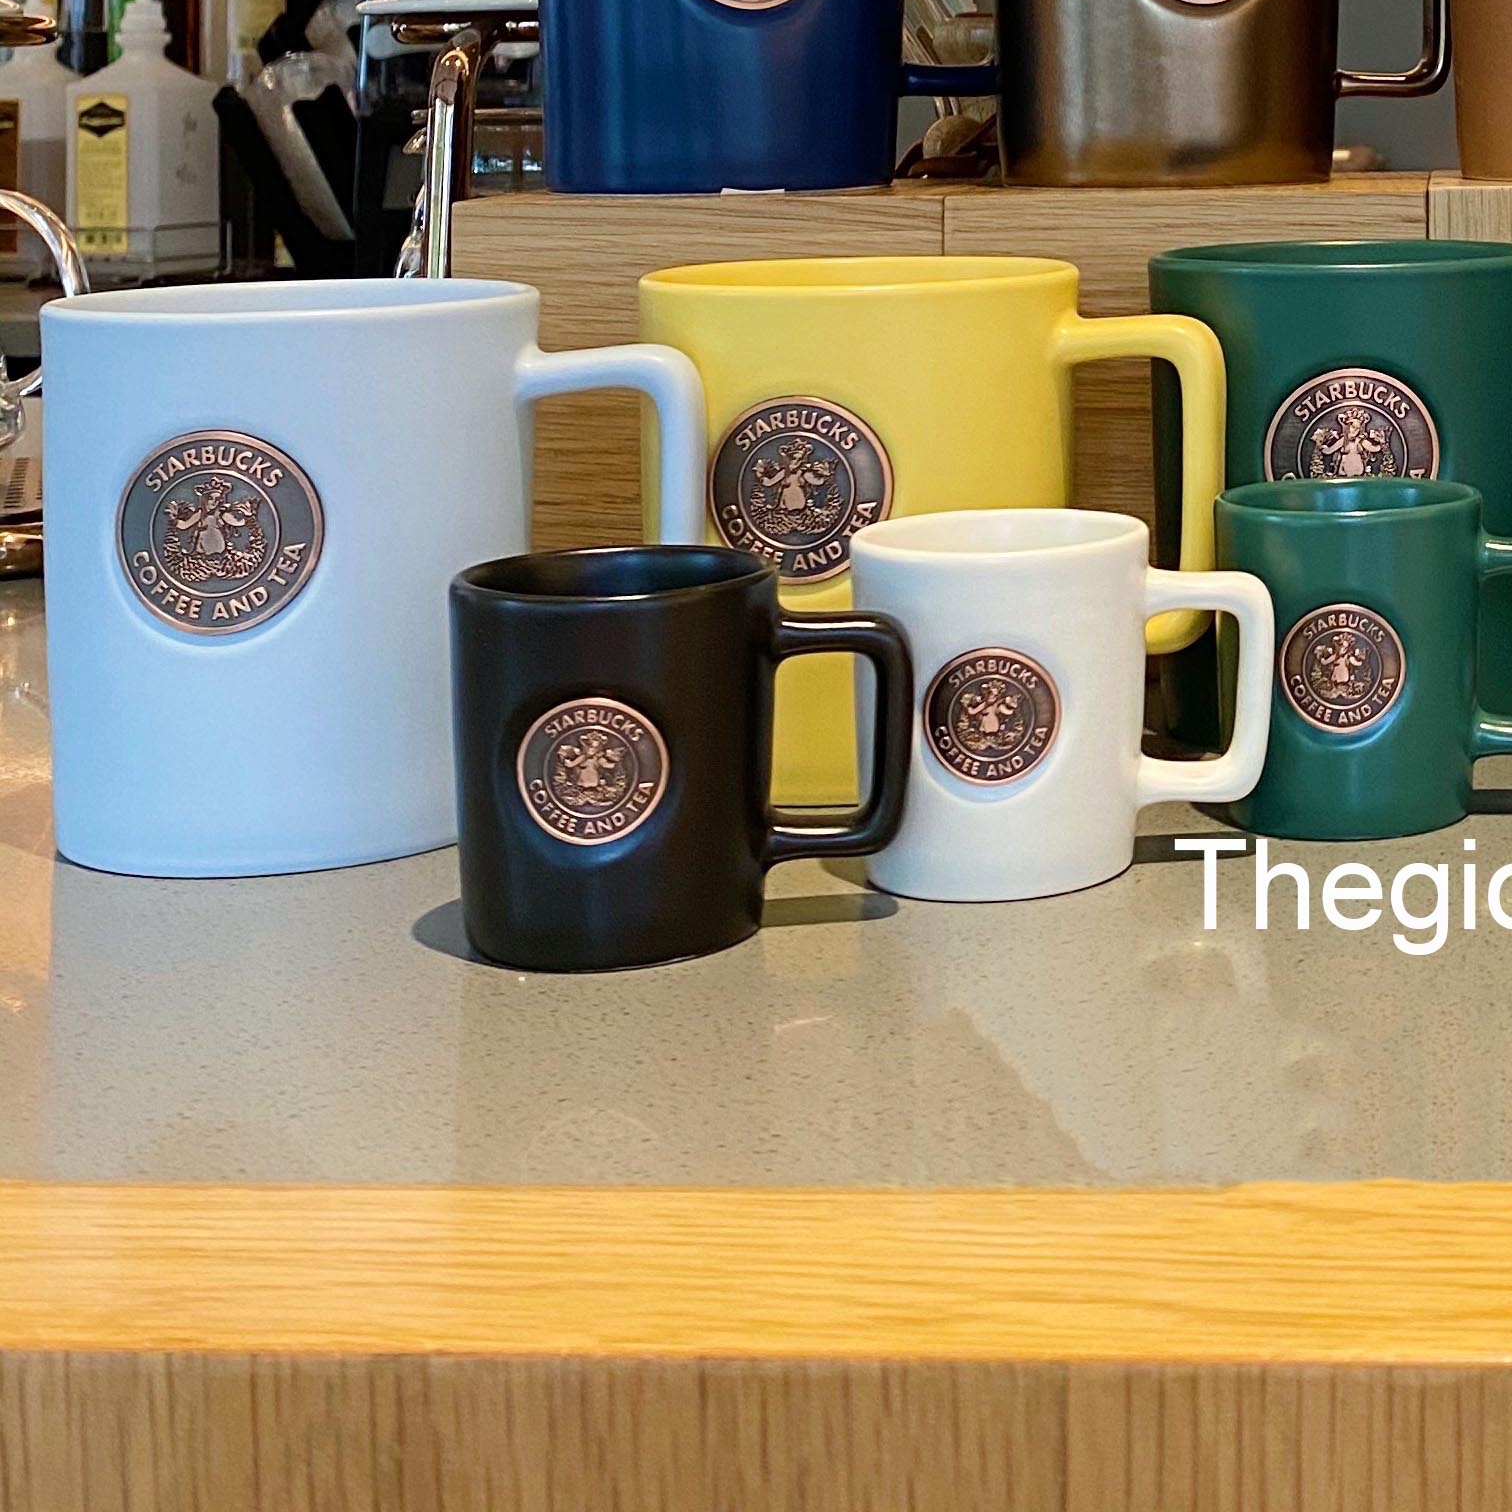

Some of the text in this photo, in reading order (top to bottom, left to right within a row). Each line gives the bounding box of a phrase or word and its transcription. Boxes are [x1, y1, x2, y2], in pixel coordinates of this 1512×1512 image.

[1293, 381, 1412, 422] STARBUCKS
[734, 410, 859, 452] STARBUCKS
[144, 445, 285, 492] STARBUCKS
[792, 540, 843, 571] AND
[133, 542, 306, 621] COFFEE AND TEA
[1302, 614, 1384, 641] STARBUCKS
[948, 661, 1040, 689] STARBUCKS
[1291, 675, 1394, 724] COFFEE AND TEA
[545, 710, 643, 742] STARBUCKS
[935, 725, 1048, 776] COFFEE AND TEA
[529, 780, 654, 835] COFFEE AND TEA
